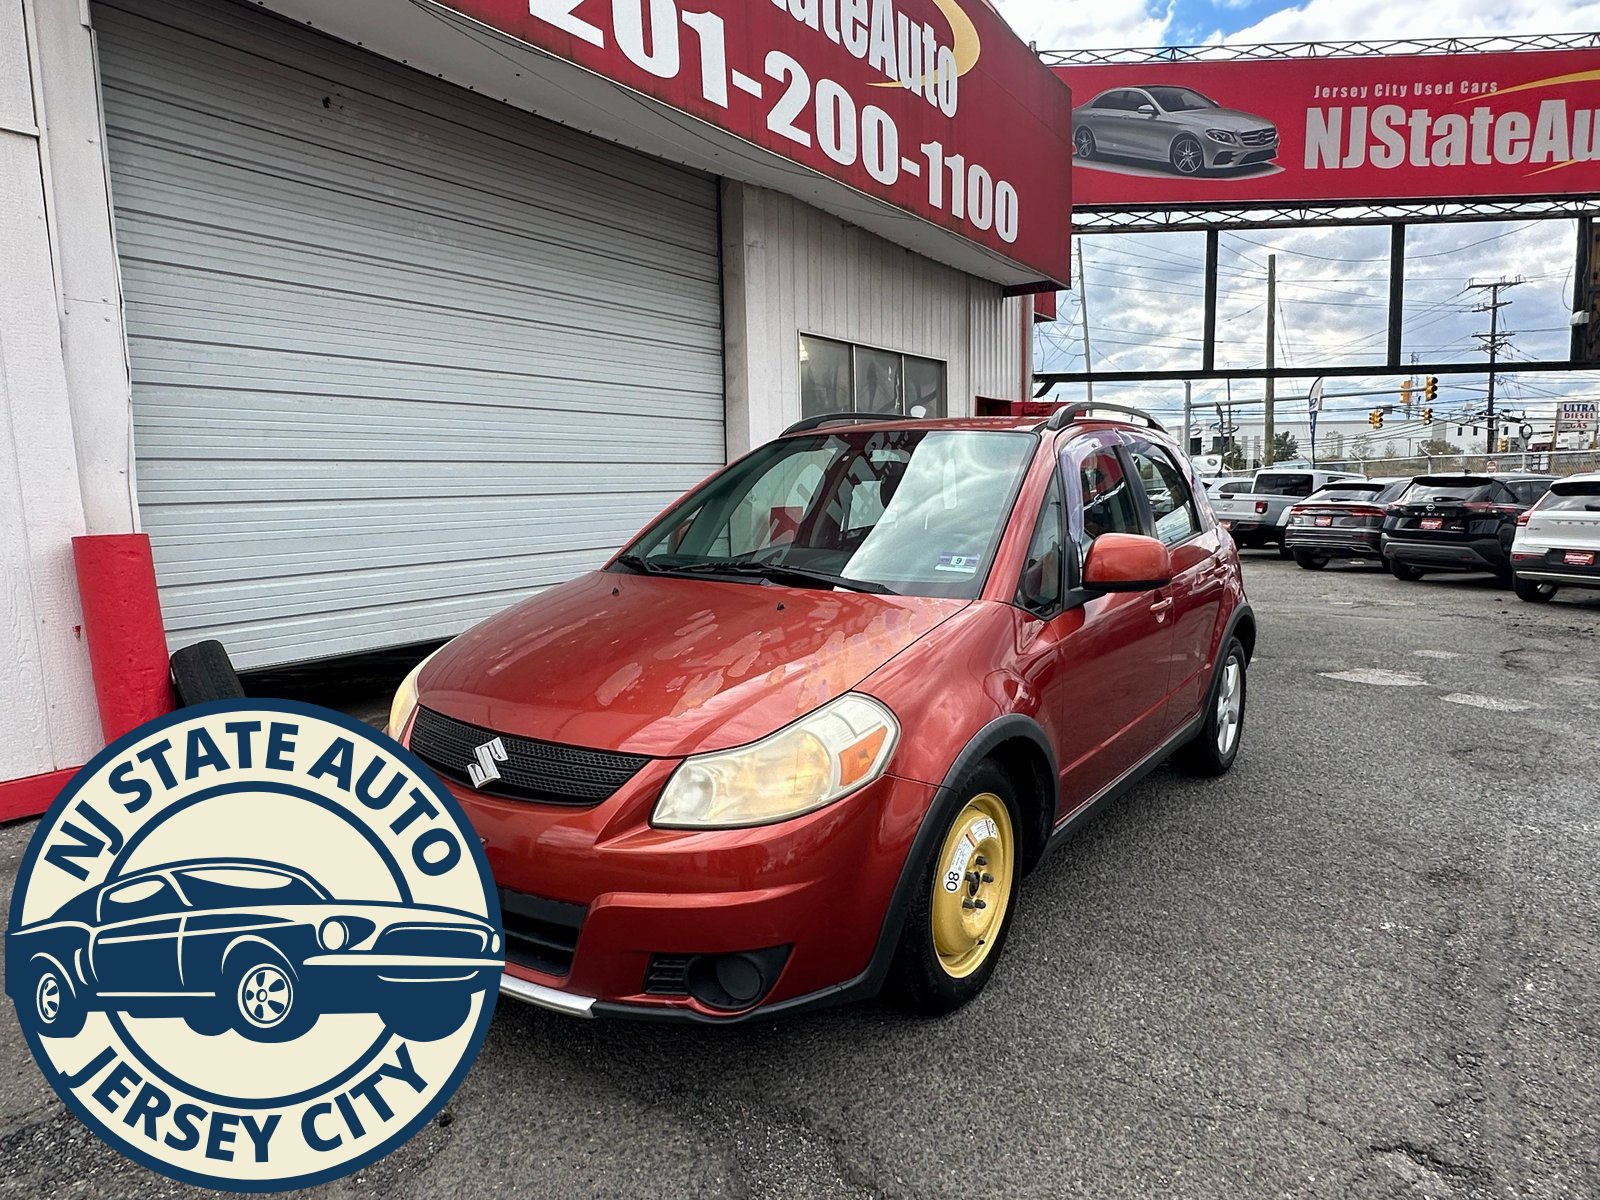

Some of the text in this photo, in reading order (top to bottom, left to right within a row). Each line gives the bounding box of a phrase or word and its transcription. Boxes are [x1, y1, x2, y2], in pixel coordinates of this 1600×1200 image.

[1314, 80, 1498, 98] Jersey City Used Cars
[1563, 403, 1596, 412] ULTRA
